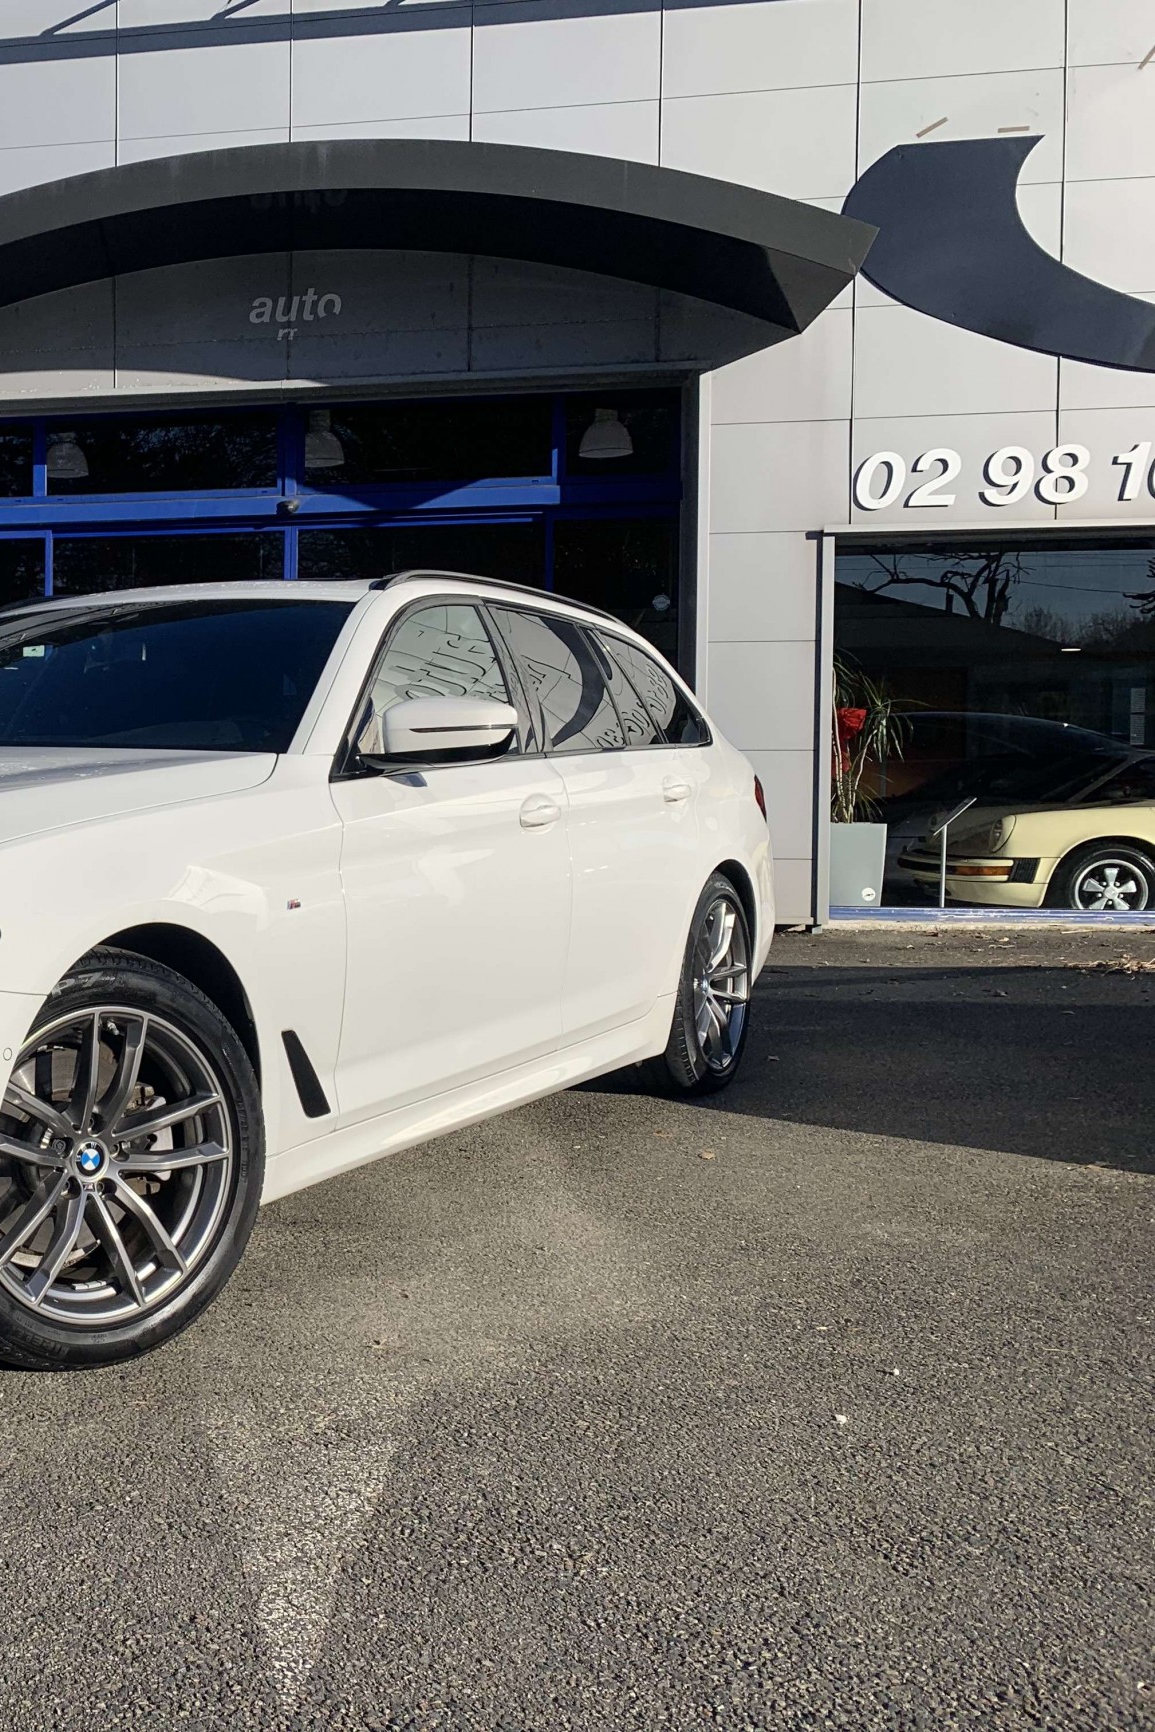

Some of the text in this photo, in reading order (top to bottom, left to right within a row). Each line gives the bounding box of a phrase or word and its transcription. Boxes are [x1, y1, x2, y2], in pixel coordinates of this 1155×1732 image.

[249, 287, 343, 324] auto
[852, 441, 1155, 512] 02 98 1
